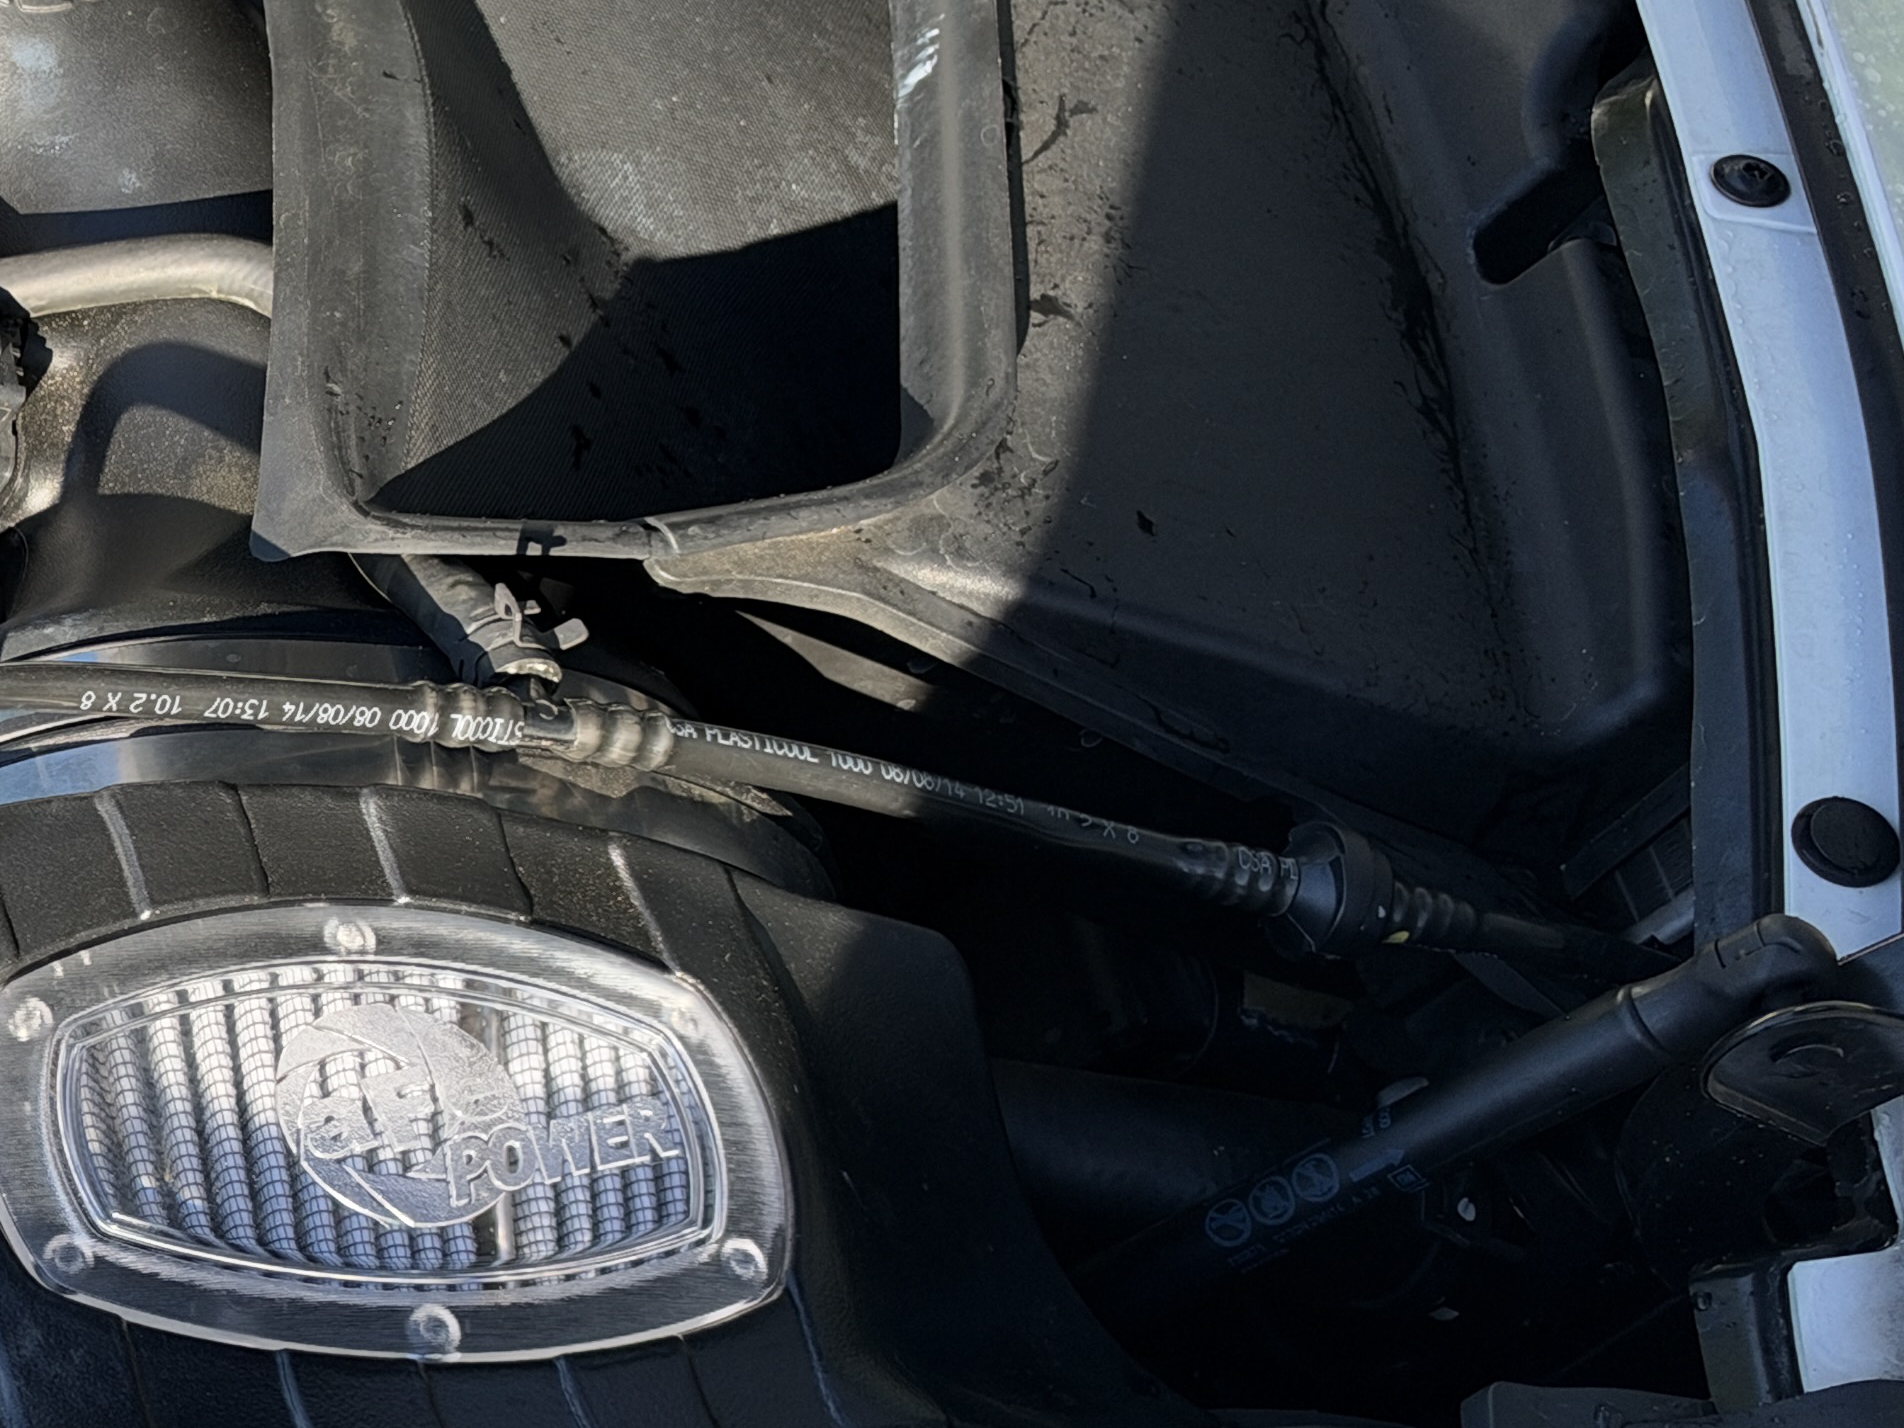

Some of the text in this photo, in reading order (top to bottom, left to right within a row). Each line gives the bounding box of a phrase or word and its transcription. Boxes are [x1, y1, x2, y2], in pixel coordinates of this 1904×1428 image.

[80, 690, 97, 711] 8
[129, 692, 182, 716] 10.2
[204, 696, 269, 721] 13:07
[282, 701, 381, 727] 08/08/14
[389, 709, 439, 736] 1000
[444, 1096, 680, 1208] POWER
